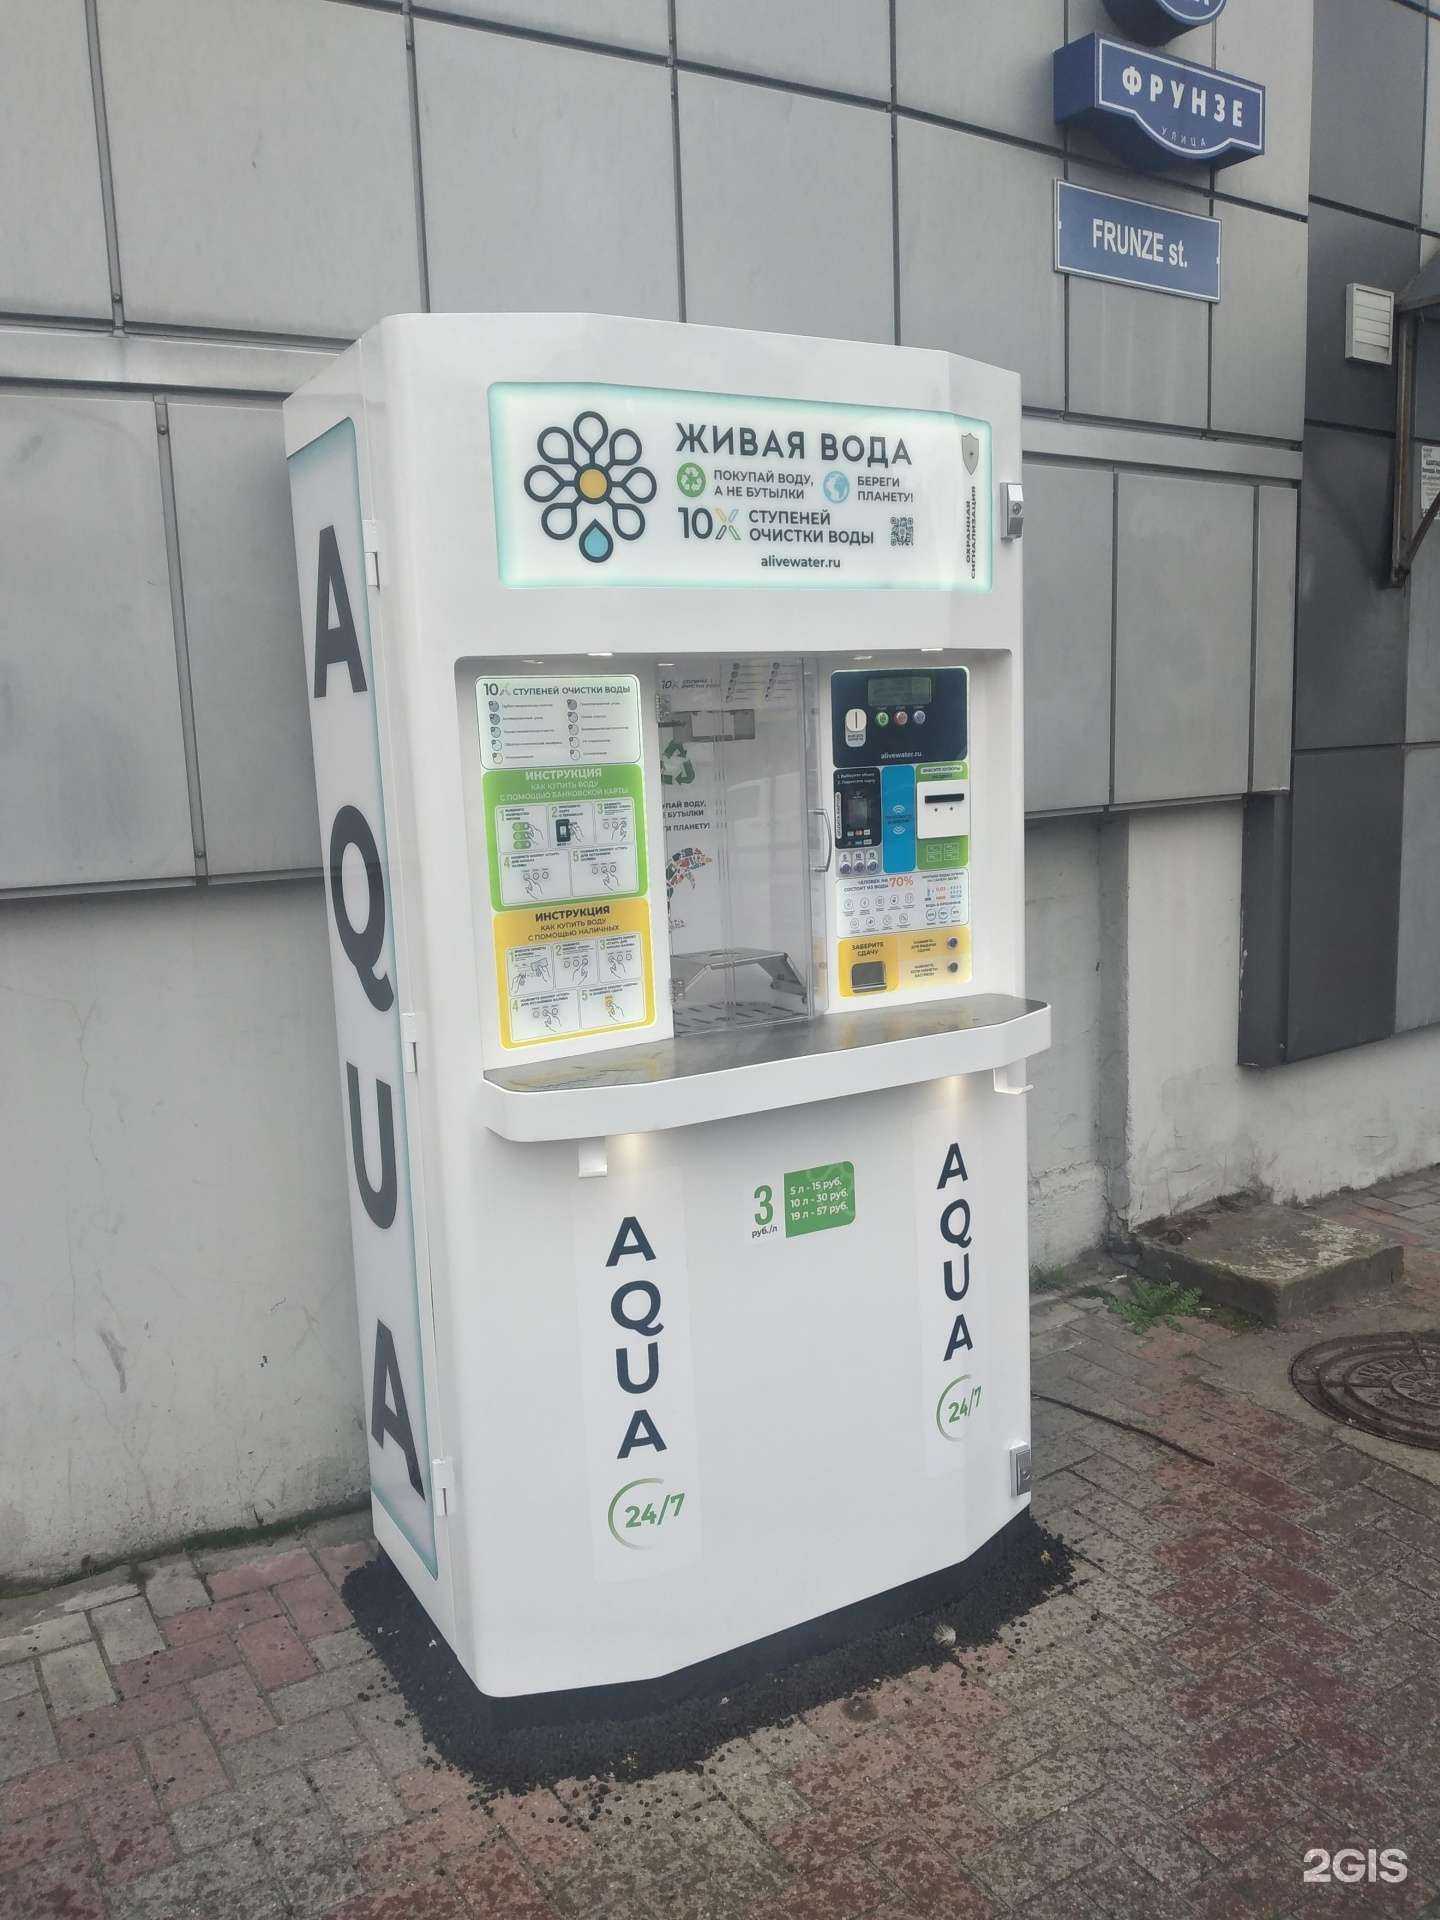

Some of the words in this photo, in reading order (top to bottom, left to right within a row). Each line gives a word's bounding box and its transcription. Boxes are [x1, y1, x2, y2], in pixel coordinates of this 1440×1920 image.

[1122, 66, 1243, 128] ФРУНЗЕ
[1162, 127, 1207, 147] УЛИЦА
[1093, 218, 1164, 263] FRUNZE
[1168, 240, 1188, 268] st.
[676, 423, 805, 459] ЖИВАЯ
[820, 433, 913, 468] ВОДА
[714, 469, 775, 483] ПОКУПАЙ
[778, 474, 814, 487] ВОДУ,
[857, 476, 900, 488] БЕРЕГИ
[714, 487, 723, 496] А
[726, 487, 742, 497] НЕ
[746, 488, 805, 500] БУТЫЛКИ
[857, 491, 914, 503] ПЛАНЕТУ!
[749, 509, 831, 525] СТУПЕНЕЙ
[749, 528, 823, 543] ОЧИСТКИ
[829, 531, 874, 546] ВОДЫ
[761, 555, 841, 568] alivewater.ru
[513, 685, 560, 695] СТУПЕНЕЙ
[562, 686, 603, 694] ОЧИСТКИ
[604, 686, 631, 694] ВОДЫ
[525, 768, 602, 781] ИНСТРУКЦИЯ
[889, 876, 914, 888] 70%
[535, 905, 610, 922] ИНСТРУКЦИЯ
[556, 920, 586, 930] КУПИТЬ
[586, 917, 607, 926] ВОДУ
[528, 934, 534, 942] С
[535, 929, 577, 941] ПОМОЩЬЮ
[579, 924, 619, 936] НАЛИЧНЫХ
[313, 525, 426, 1501] AQUA
[790, 1186, 796, 1195] 5
[812, 1181, 821, 1190] 15
[823, 1177, 842, 1190] руб.
[754, 1185, 773, 1225] 3
[791, 1198, 800, 1208] 10
[802, 1198, 809, 1206] л
[816, 1193, 827, 1202] 30
[830, 1188, 849, 1201] руб.
[791, 1211, 800, 1221] 19
[802, 1211, 809, 1219] л
[816, 1206, 827, 1216] 57
[830, 1201, 849, 1215] руб.
[752, 1225, 778, 1238] руб./л
[937, 1142, 973, 1362] AQUA
[606, 1216, 667, 1459] AQUA
[949, 1386, 982, 1423] 24/7
[625, 1492, 685, 1528] 24/7
